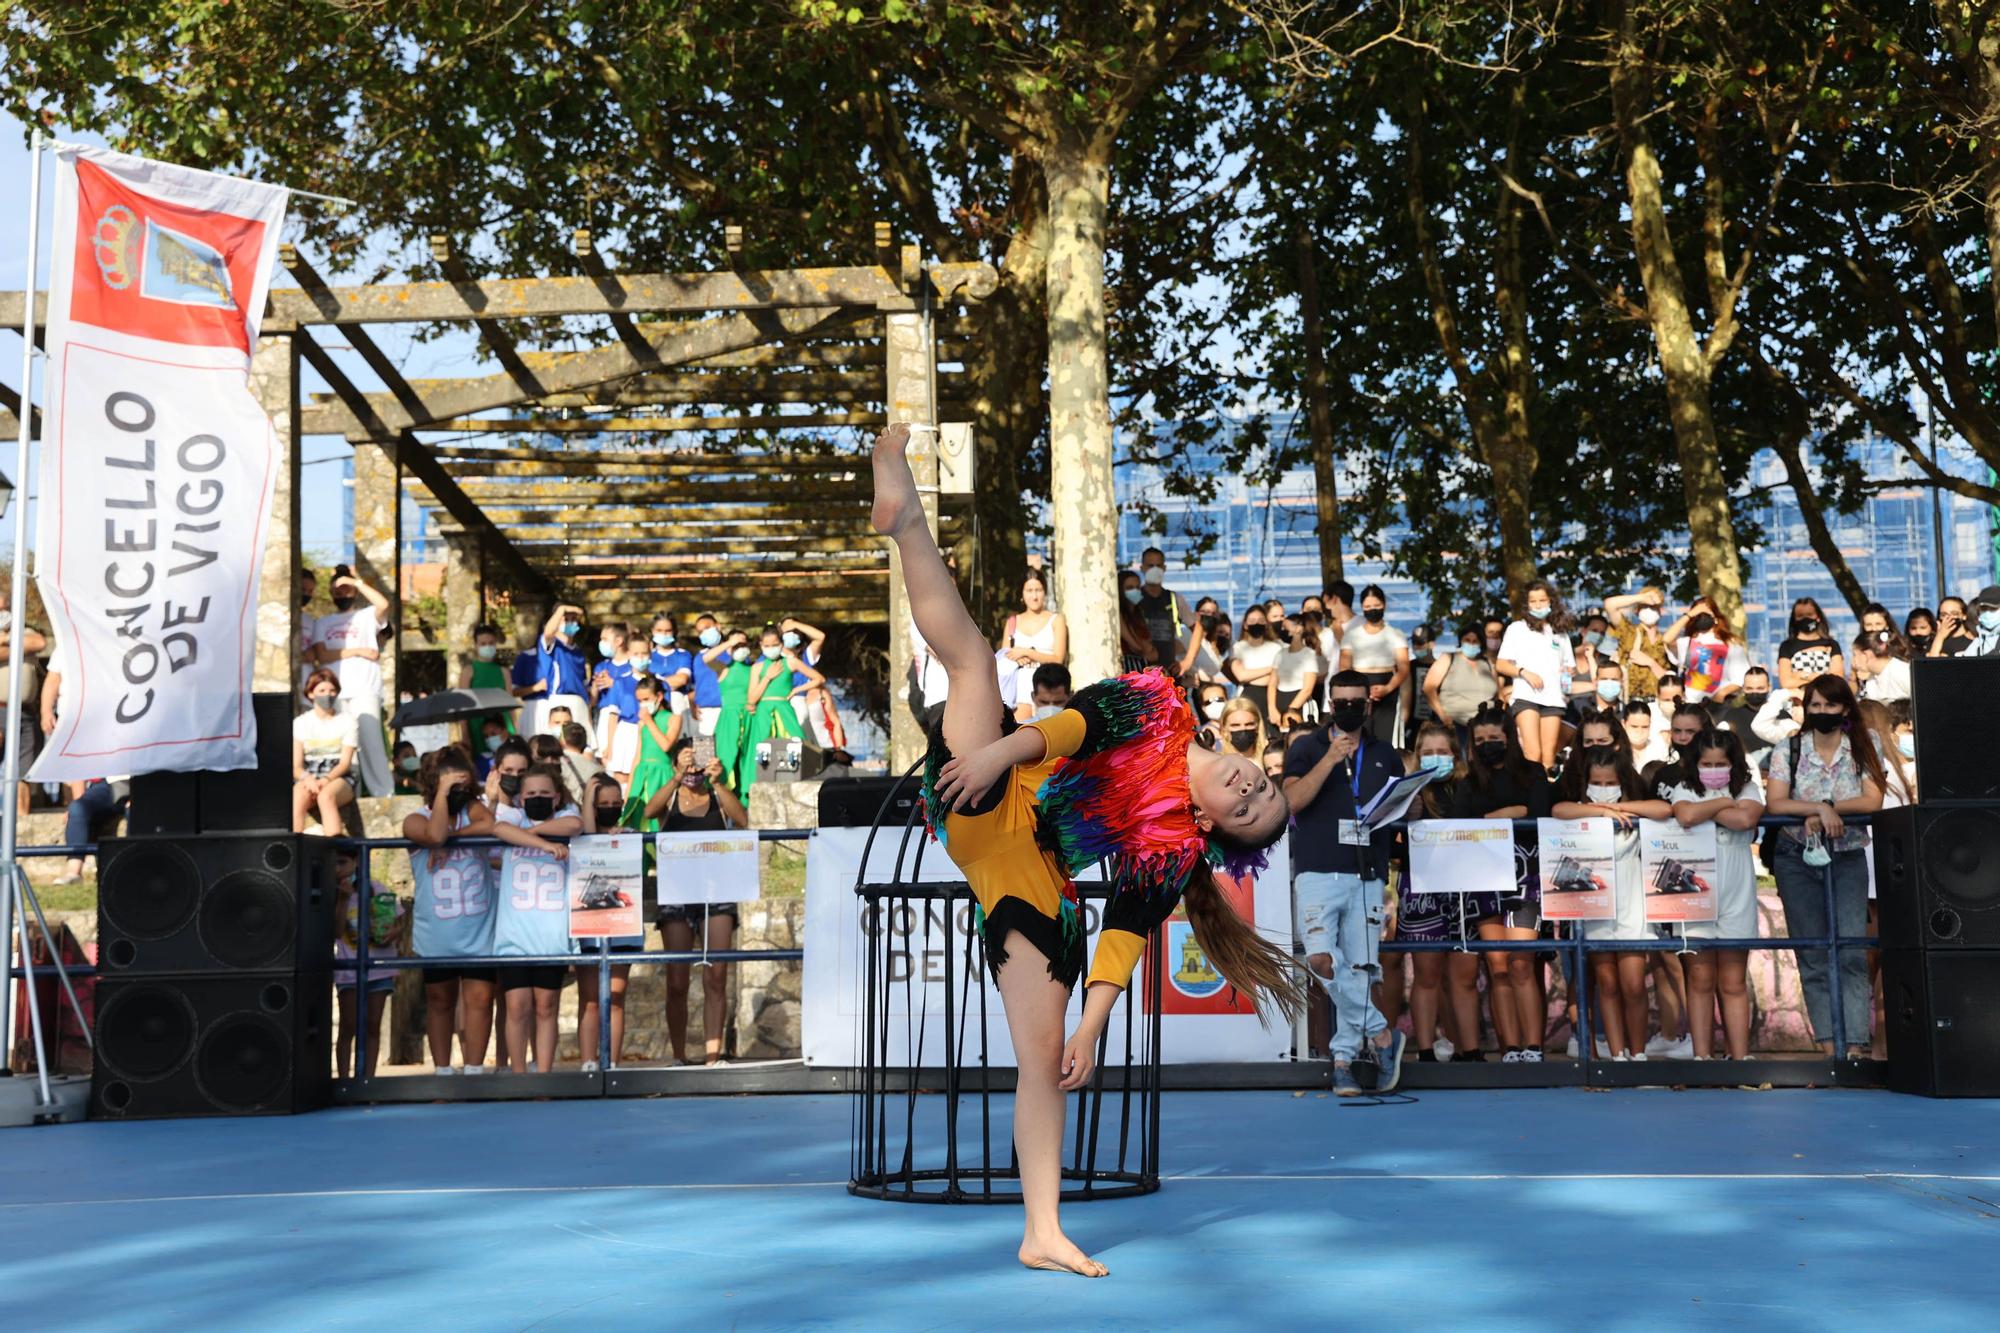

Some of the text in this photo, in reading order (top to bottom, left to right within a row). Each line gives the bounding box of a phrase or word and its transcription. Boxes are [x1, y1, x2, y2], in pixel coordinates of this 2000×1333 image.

[104, 391, 157, 723] CONCELLO
[161, 434, 226, 674] DE VIGO
[432, 866, 488, 919] 92
[511, 861, 564, 911] 92
[890, 950, 945, 983] DE
